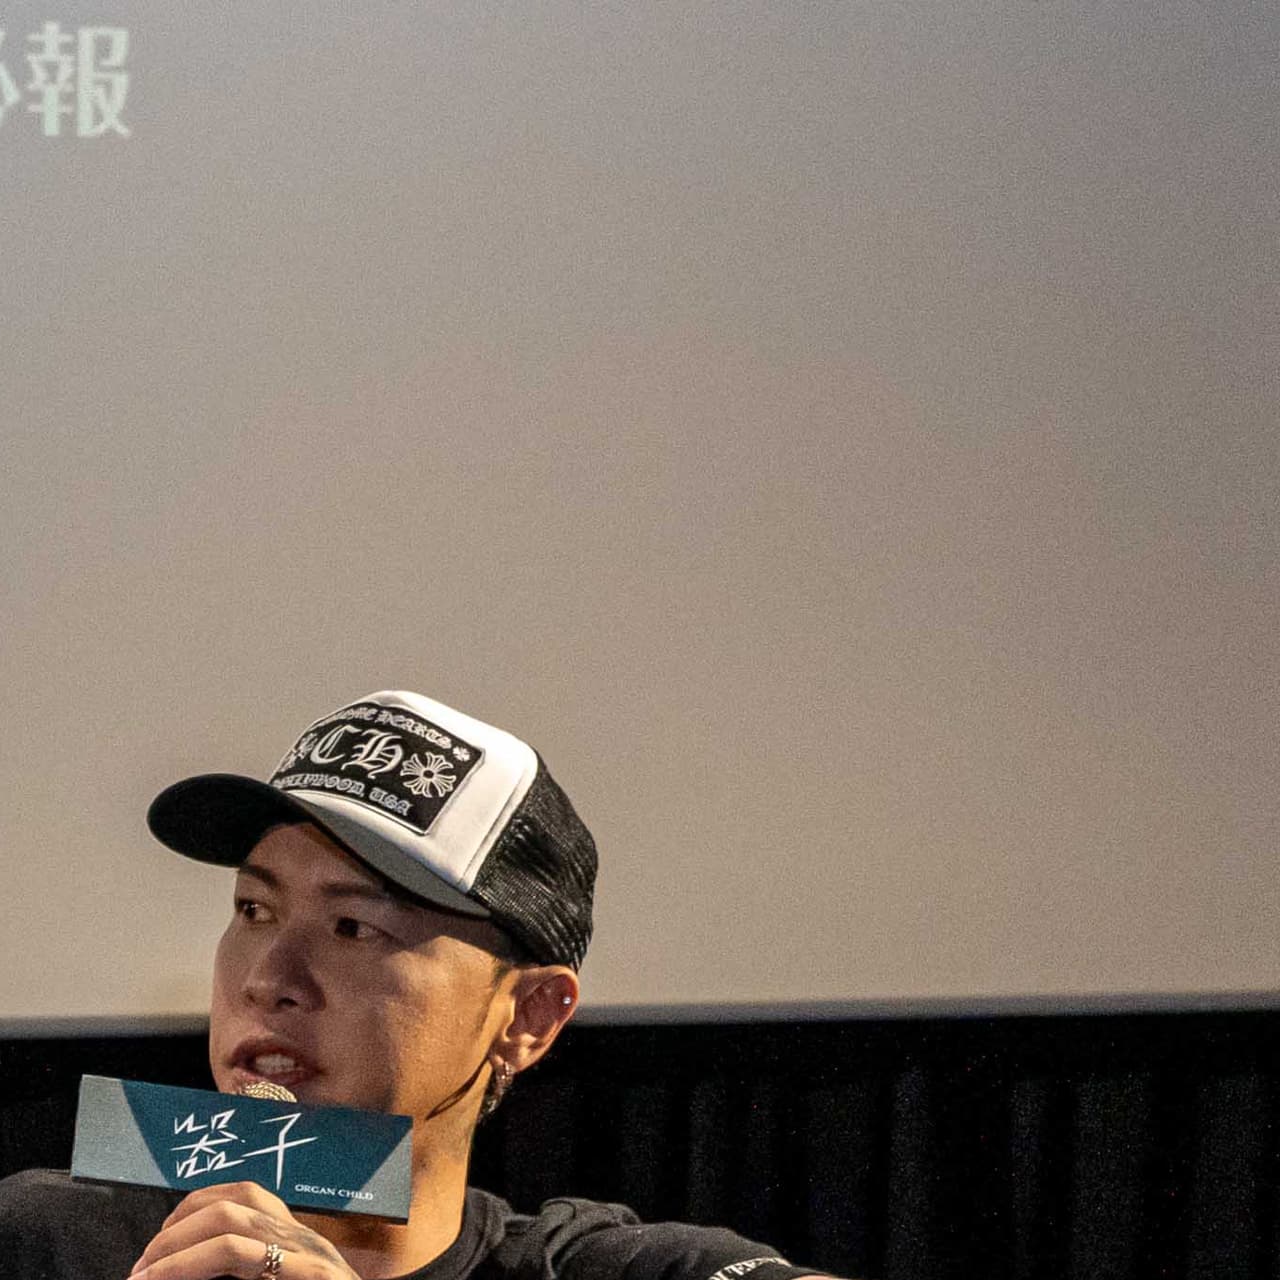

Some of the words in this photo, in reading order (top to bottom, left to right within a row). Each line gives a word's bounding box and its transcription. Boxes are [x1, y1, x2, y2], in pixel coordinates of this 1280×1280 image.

[308, 724, 405, 780] CH
[368, 785, 415, 817] USA
[294, 1183, 337, 1196] ORGAN
[337, 1188, 374, 1201] CHILD
